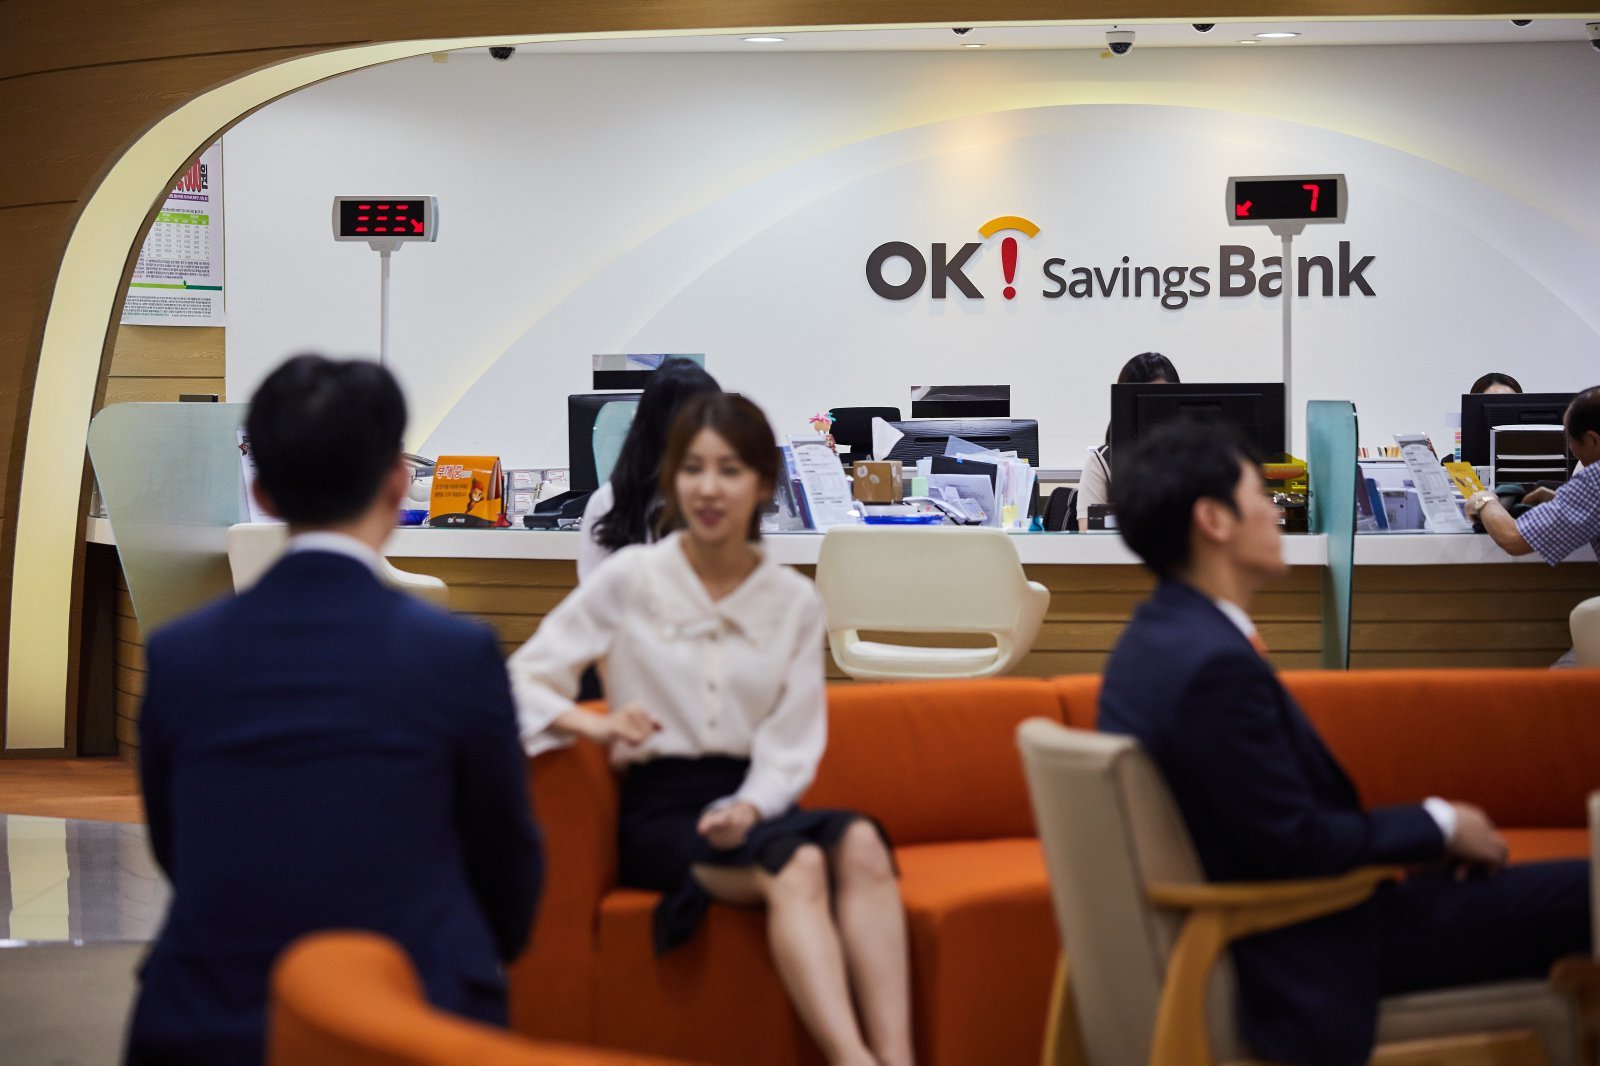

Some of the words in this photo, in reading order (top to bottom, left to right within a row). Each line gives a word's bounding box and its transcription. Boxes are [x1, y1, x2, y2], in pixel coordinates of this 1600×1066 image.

[1302, 184, 1319, 211] 7
[1042, 257, 1210, 309] Savings
[1219, 241, 1377, 297] Bank
